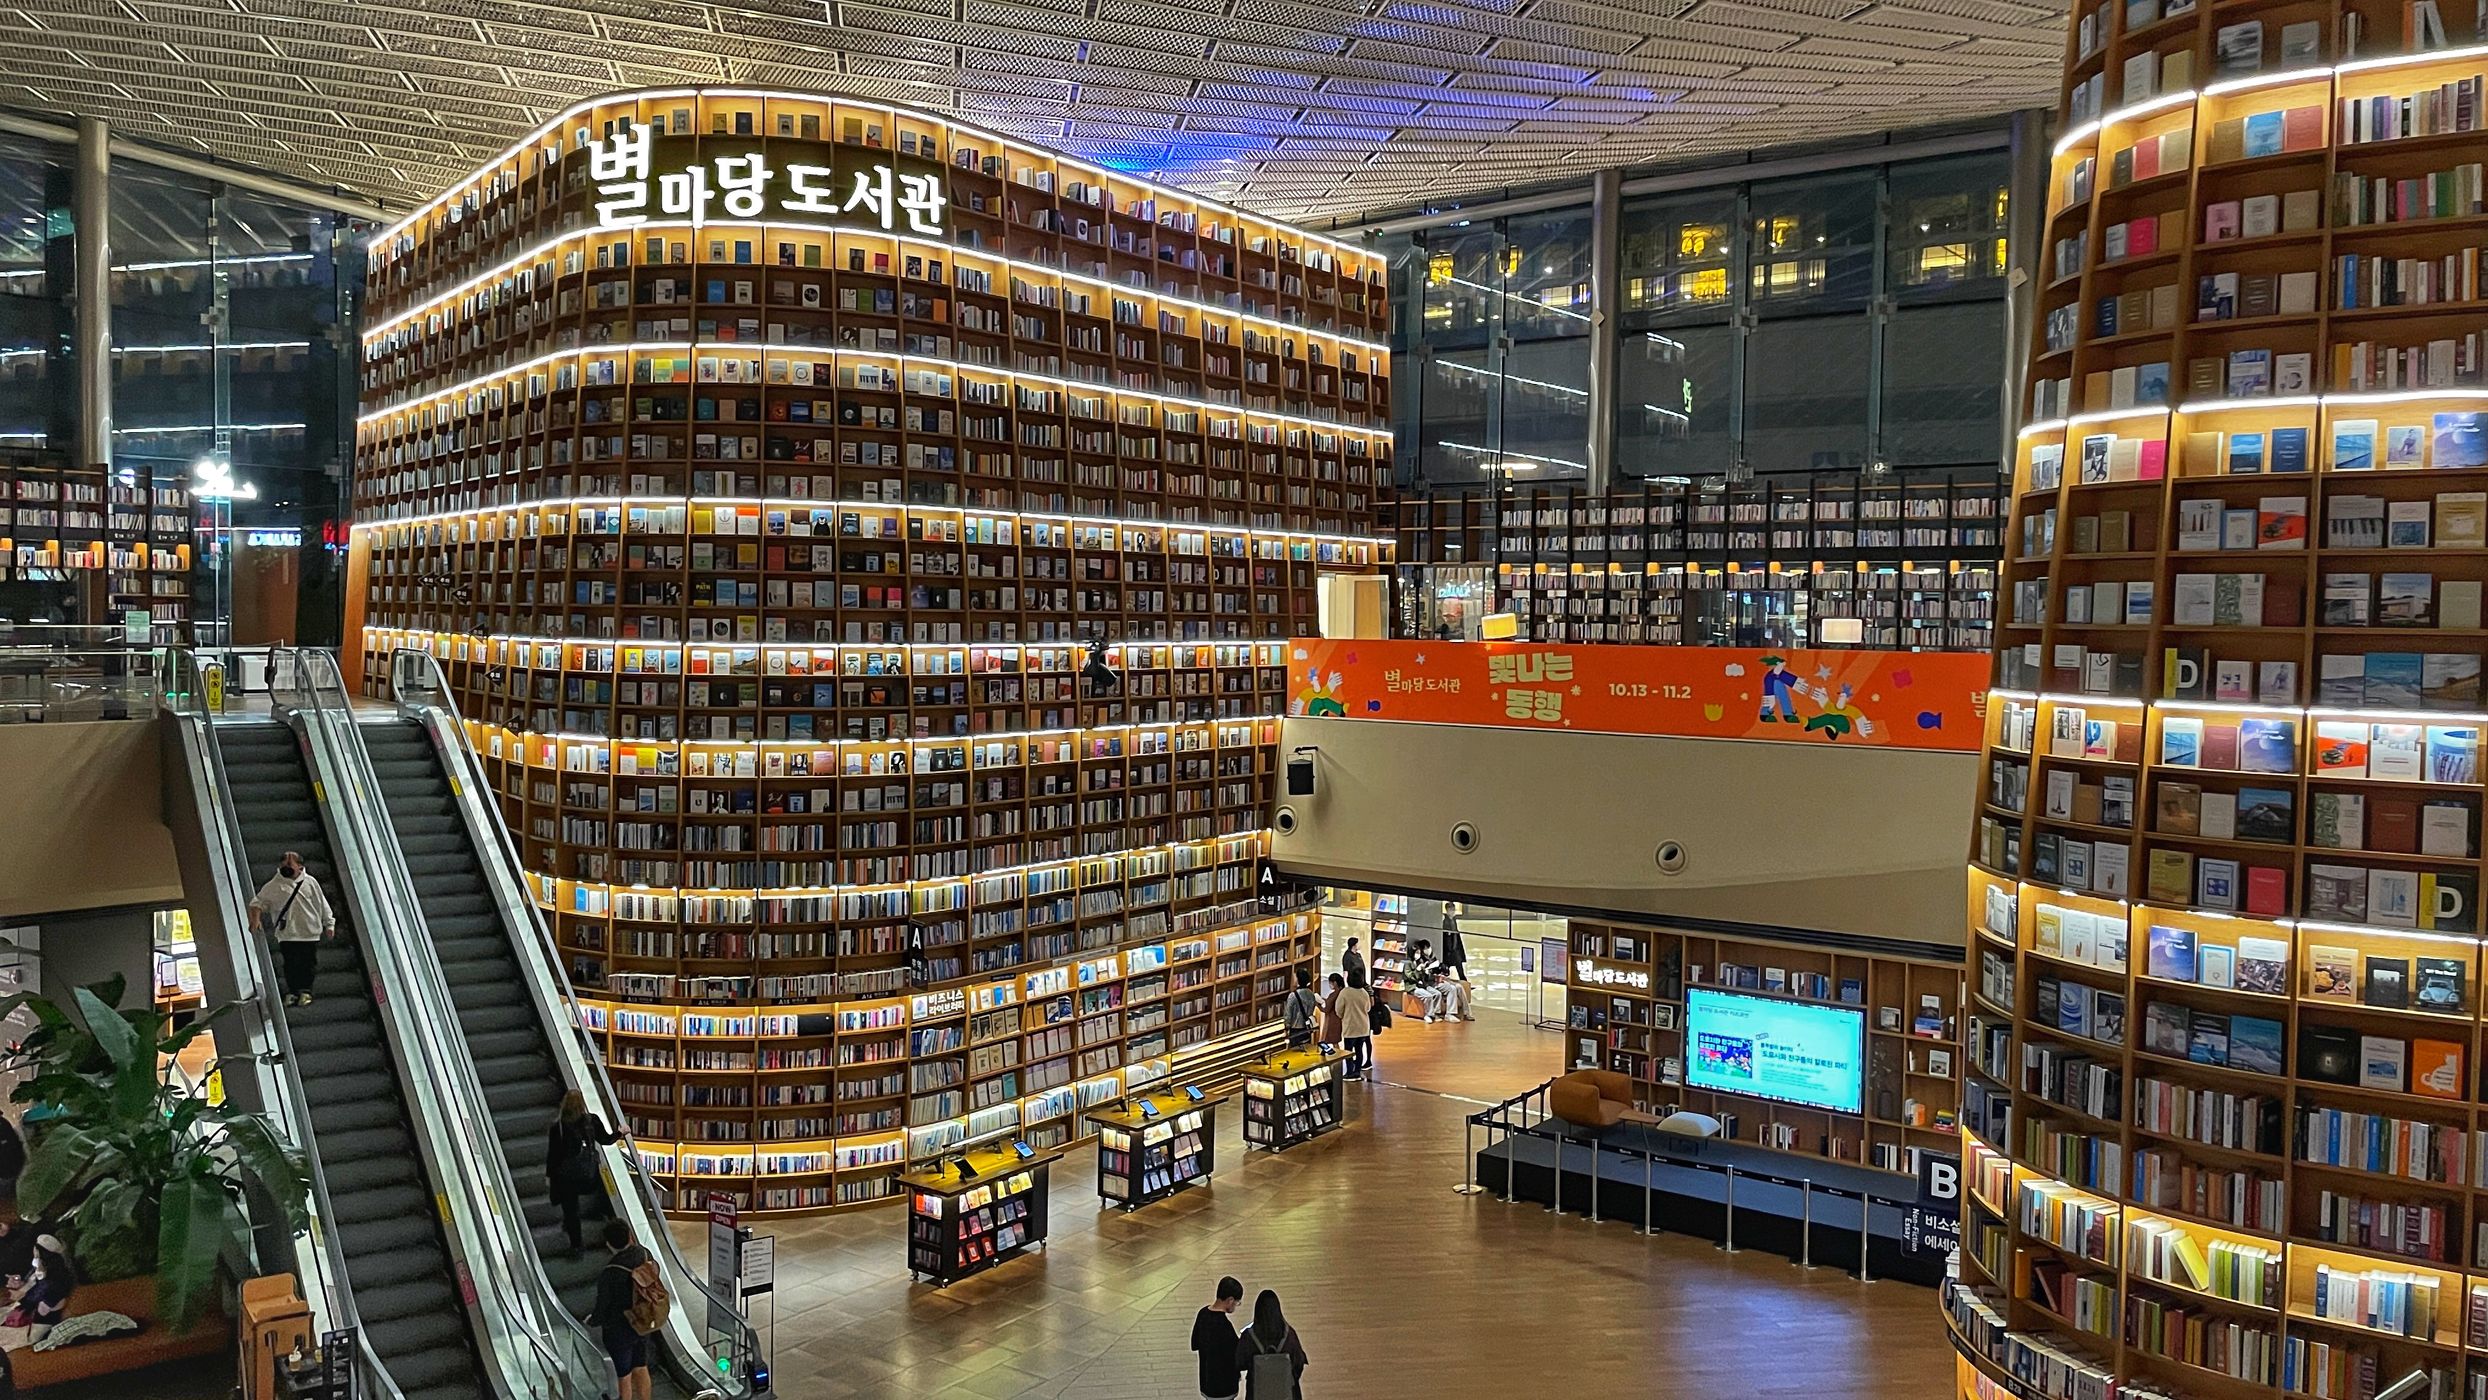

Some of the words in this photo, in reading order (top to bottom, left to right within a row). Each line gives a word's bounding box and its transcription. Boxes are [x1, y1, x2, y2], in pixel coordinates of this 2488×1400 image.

[587, 123, 772, 229] 별마당
[779, 164, 947, 236] 도서관
[1488, 651, 1574, 685] 빛나는
[1384, 669, 1425, 695] 별마당
[1426, 677, 1461, 694] 도서관
[1609, 683, 1647, 698] 10.13
[1663, 685, 1691, 699] 11.2
[1505, 688, 1563, 722] 동행
[1261, 866, 1274, 885] A
[1259, 895, 1275, 906] 소설
[912, 927, 922, 950] A
[1576, 960, 1614, 984] 별마당
[1614, 971, 1649, 988] 도서관
[928, 989, 965, 1005] 비즈니스
[928, 1000, 965, 1015] 라이브러리
[1931, 1162, 1958, 1199] B
[714, 1203, 732, 1213] NOW
[1903, 1217, 1912, 1240] Essay
[1912, 1208, 1920, 1252] Non-Fiction
[1925, 1215, 1961, 1235] 비소설
